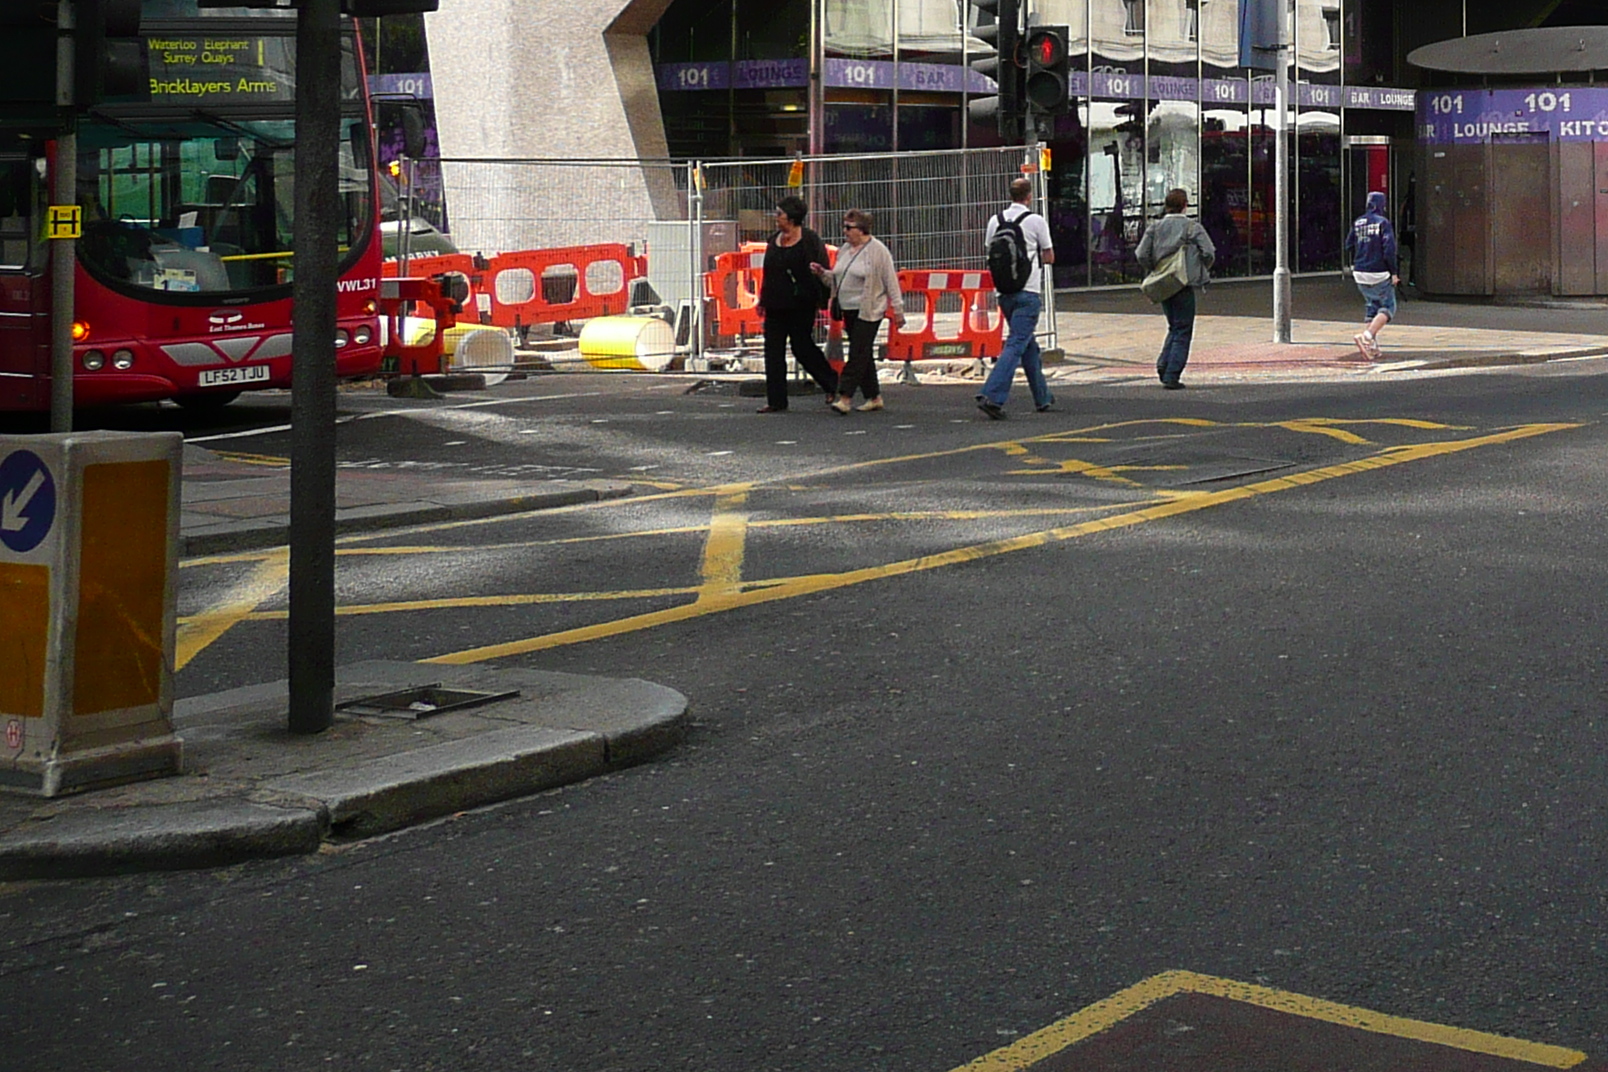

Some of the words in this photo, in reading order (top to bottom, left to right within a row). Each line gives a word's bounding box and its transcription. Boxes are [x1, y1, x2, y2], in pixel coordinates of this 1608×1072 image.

[148, 38, 197, 51] Waterloo
[204, 38, 249, 52] Elephant
[163, 51, 197, 65] Surrey
[201, 51, 235, 65] Quays
[677, 67, 709, 86] 101
[844, 65, 875, 84] 101
[149, 78, 231, 97] Bricklayers
[236, 77, 277, 93] Arms
[397, 78, 424, 96] 101
[1106, 78, 1130, 95] 101
[1152, 81, 1195, 96] LOUNGE
[1214, 84, 1236, 100] 101
[1310, 89, 1330, 106] 101
[1351, 91, 1370, 104] BAR
[1380, 92, 1415, 106] LOUNGE
[1432, 94, 1463, 115] 101
[1524, 92, 1572, 112] 101
[1453, 121, 1531, 139] LOUNGE
[337, 277, 377, 293] VWL31
[204, 369, 238, 384] LF52
[240, 366, 265, 381] TJU
